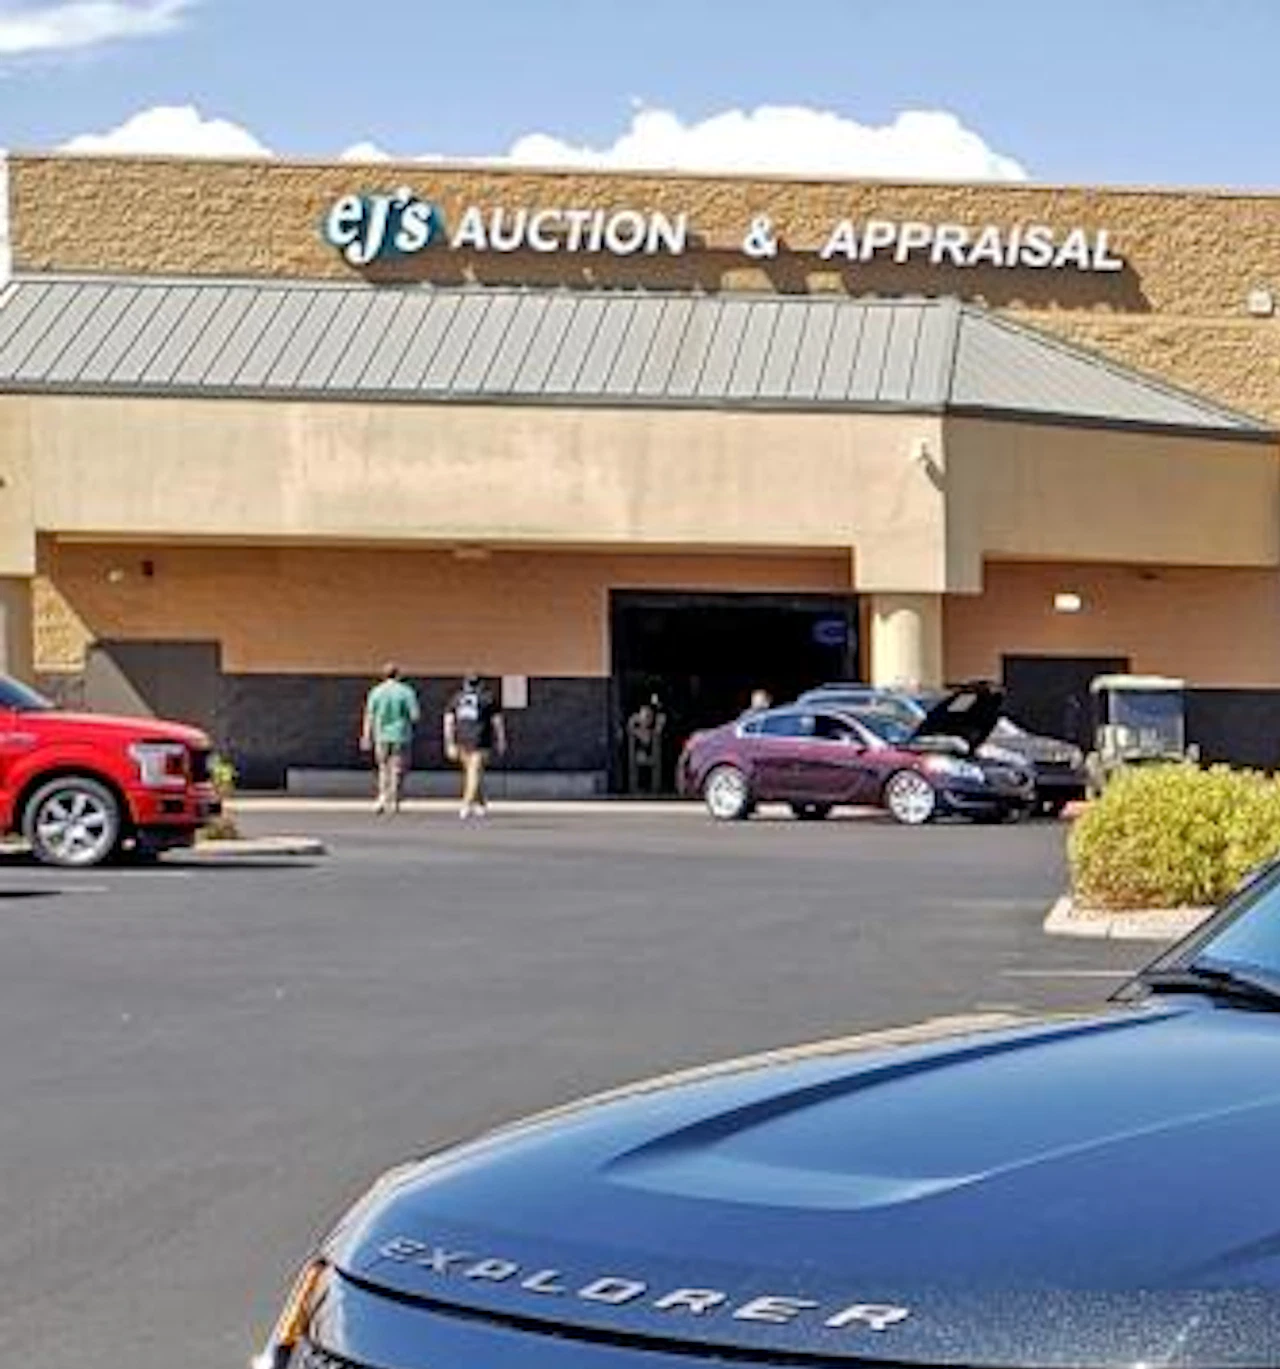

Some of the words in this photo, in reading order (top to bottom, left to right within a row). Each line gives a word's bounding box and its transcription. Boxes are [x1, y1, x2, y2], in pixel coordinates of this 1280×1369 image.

[451, 206, 688, 255] AUCTION
[743, 214, 778, 258] &
[819, 219, 1124, 272] APPRAISAL
[378, 1237, 910, 1332] EXPLORER
